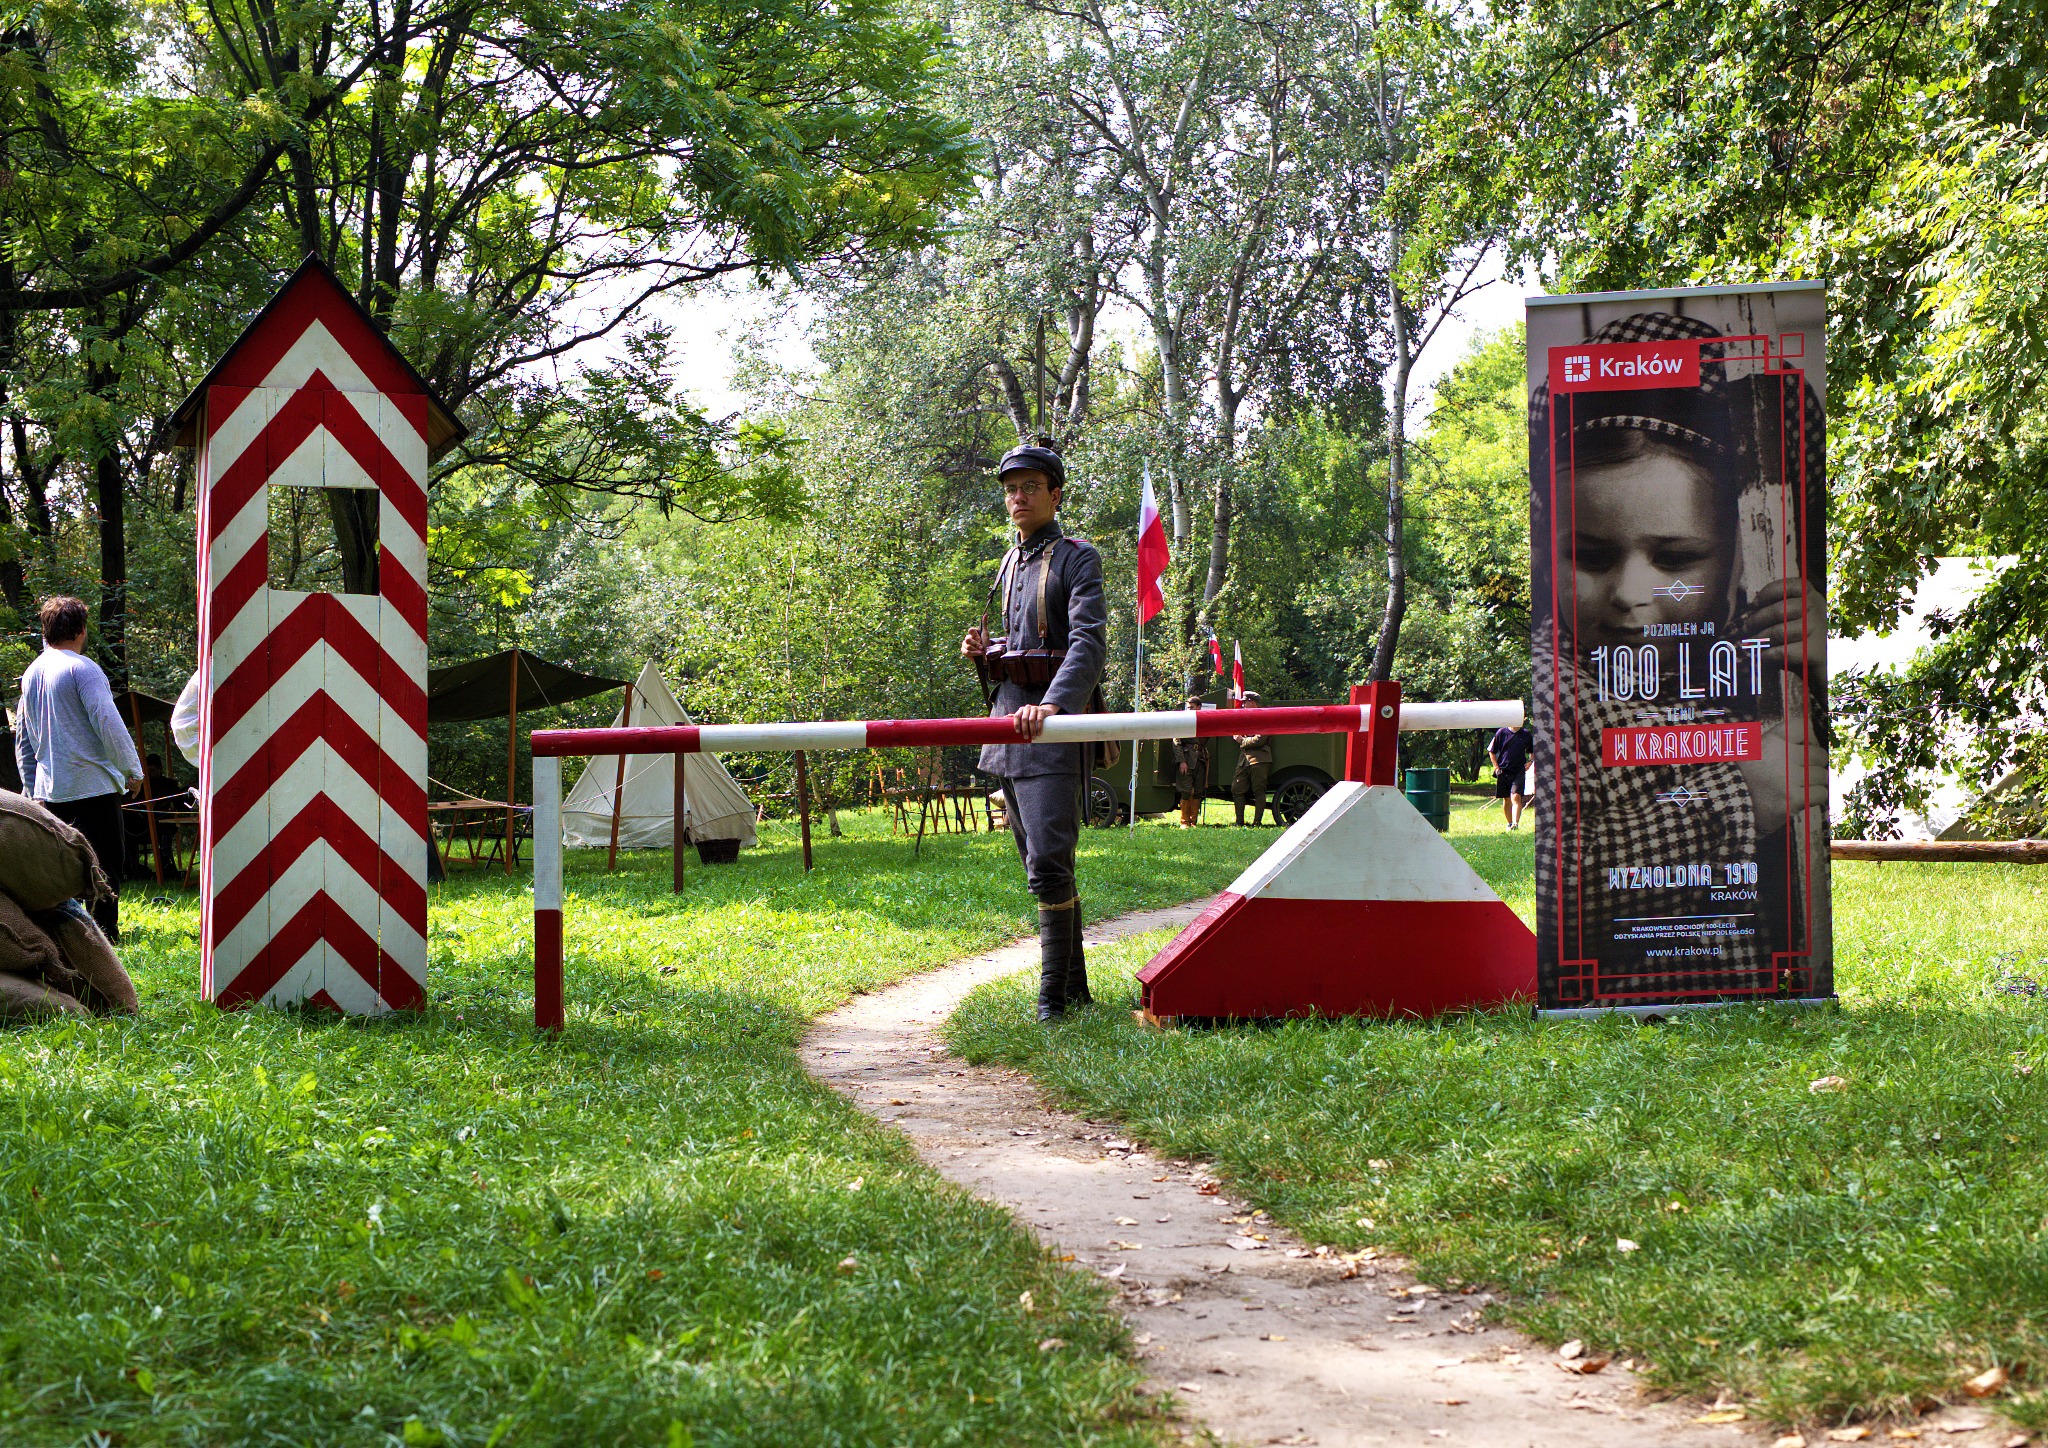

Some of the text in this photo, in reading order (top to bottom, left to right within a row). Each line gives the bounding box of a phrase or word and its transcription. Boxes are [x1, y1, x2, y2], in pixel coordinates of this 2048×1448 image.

[1600, 353, 1683, 377] Kraków
[1700, 621, 1715, 637] JĄ
[1591, 638, 1770, 702] 100 LAT
[1666, 707, 1695, 721] TEMU
[1614, 728, 1748, 761] W KRAKOWIE
[1710, 889, 1758, 901] KRAKÓW
[1702, 928, 1755, 936] NIEPODLEGŁOŚCI
[1646, 945, 1723, 957] www.krakow.pl
